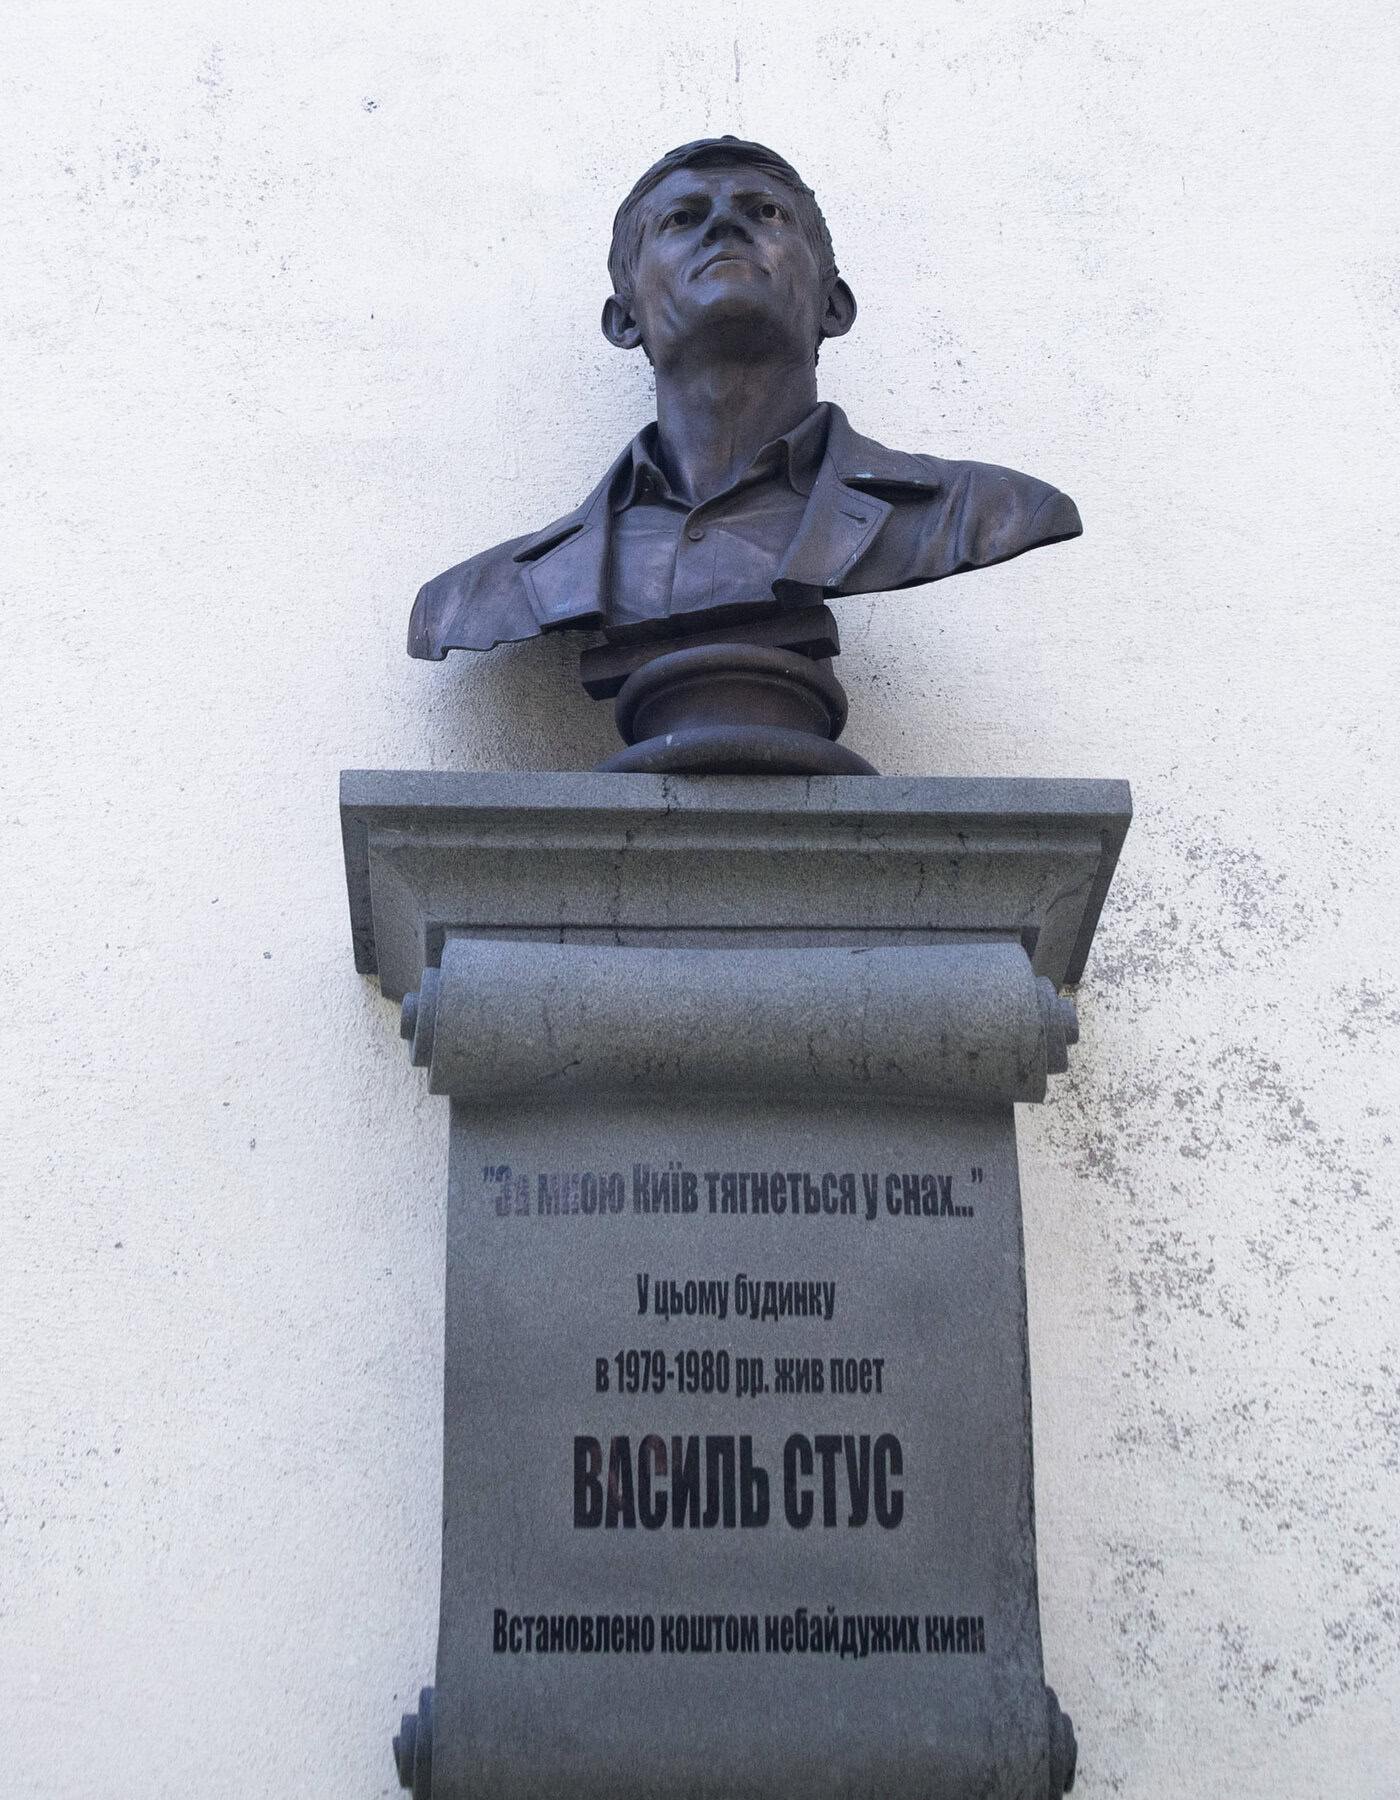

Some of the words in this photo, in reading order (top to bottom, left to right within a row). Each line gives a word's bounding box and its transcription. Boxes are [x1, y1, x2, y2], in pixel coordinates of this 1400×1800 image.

[632, 1161, 699, 1214] Київ
[704, 1172, 857, 1215] тягнеться
[864, 1174, 878, 1221] у
[636, 1275, 649, 1316] У
[654, 1281, 729, 1322] цьому
[734, 1273, 836, 1322] будинку
[595, 1359, 609, 1394] в
[614, 1351, 730, 1394] 1979-1980
[735, 1358, 769, 1397] рр.
[774, 1359, 824, 1394] жив
[830, 1358, 885, 1394] поет
[572, 1434, 770, 1530] ВАСИЛЬ
[782, 1433, 905, 1530] СТУС
[493, 1609, 655, 1653] Встановлено
[661, 1615, 760, 1653] коштом
[765, 1606, 921, 1659] небайдужих
[926, 1614, 986, 1653] киян
